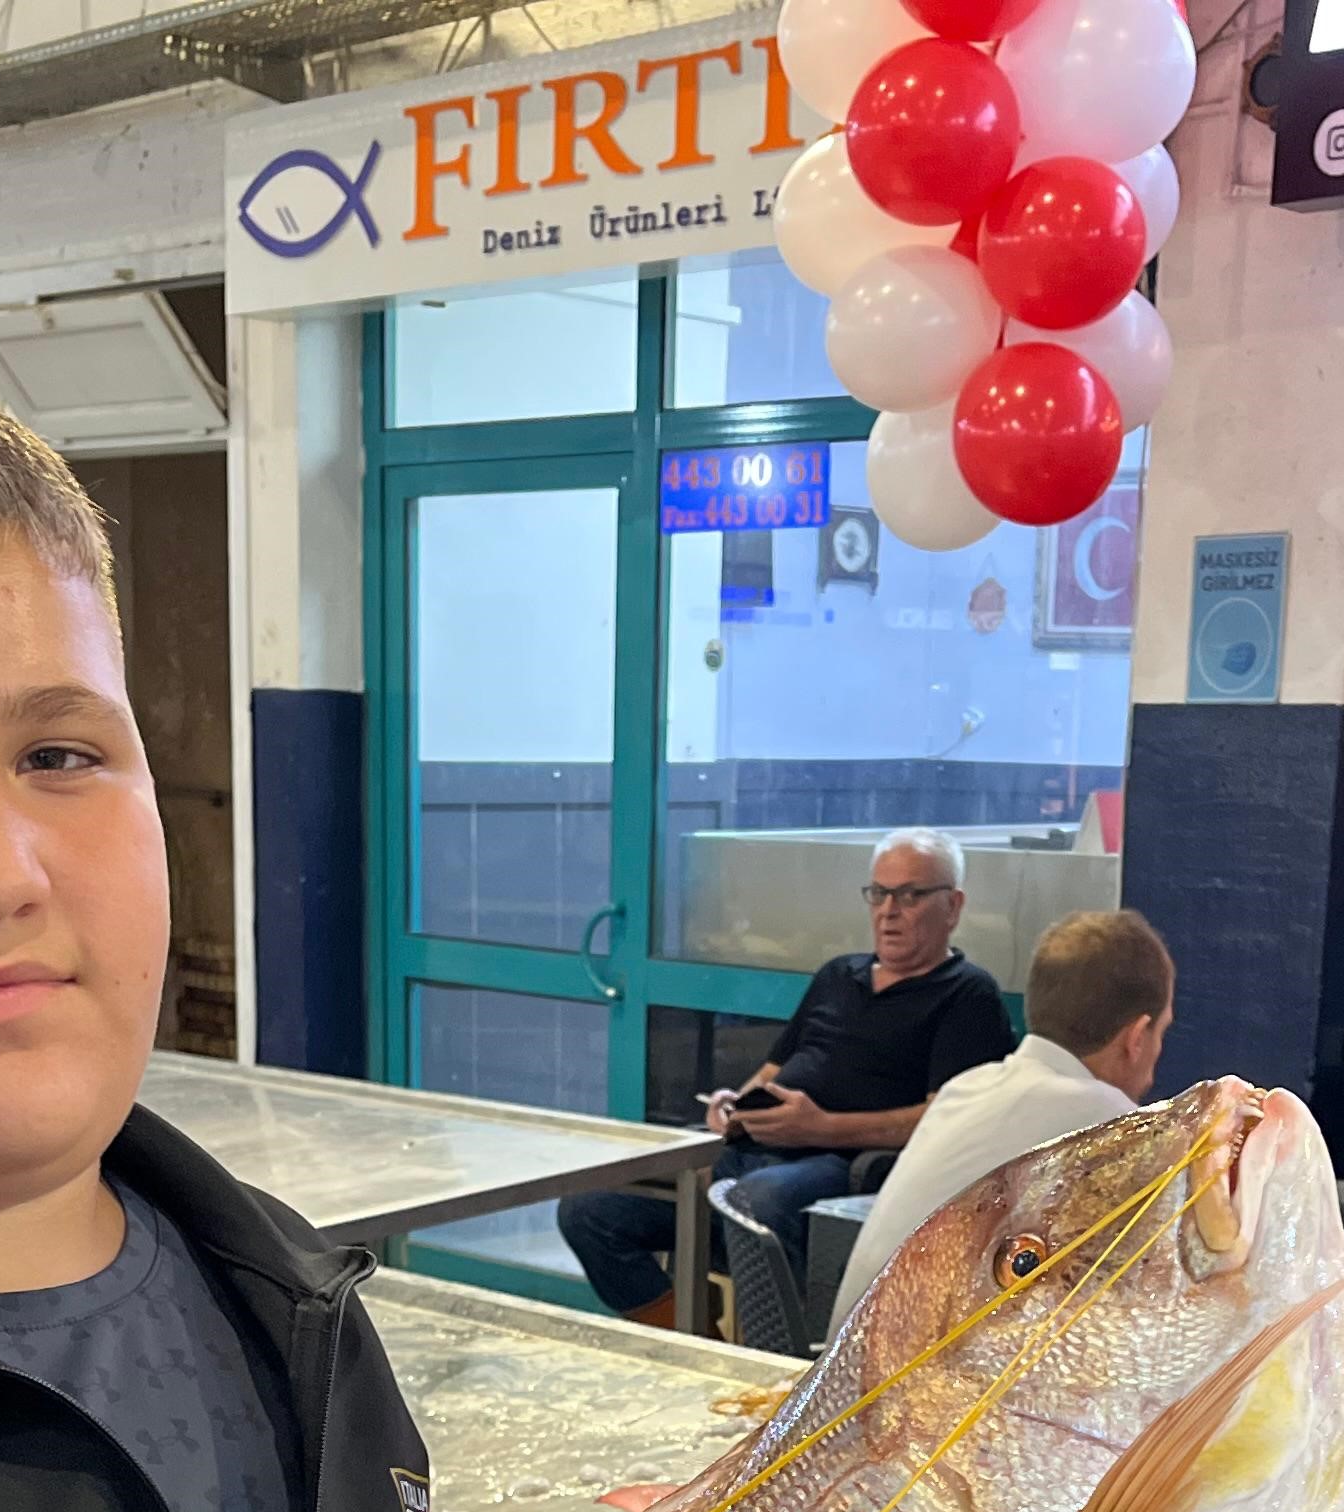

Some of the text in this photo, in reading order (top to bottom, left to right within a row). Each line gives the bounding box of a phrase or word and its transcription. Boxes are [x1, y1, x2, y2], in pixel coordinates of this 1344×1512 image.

[402, 35, 846, 242] FIRTI
[482, 186, 780, 254] Deniz Ürünleri L
[664, 450, 824, 490] 443 00 61
[794, 489, 824, 524] 31
[1199, 547, 1279, 570] MASKESİZ
